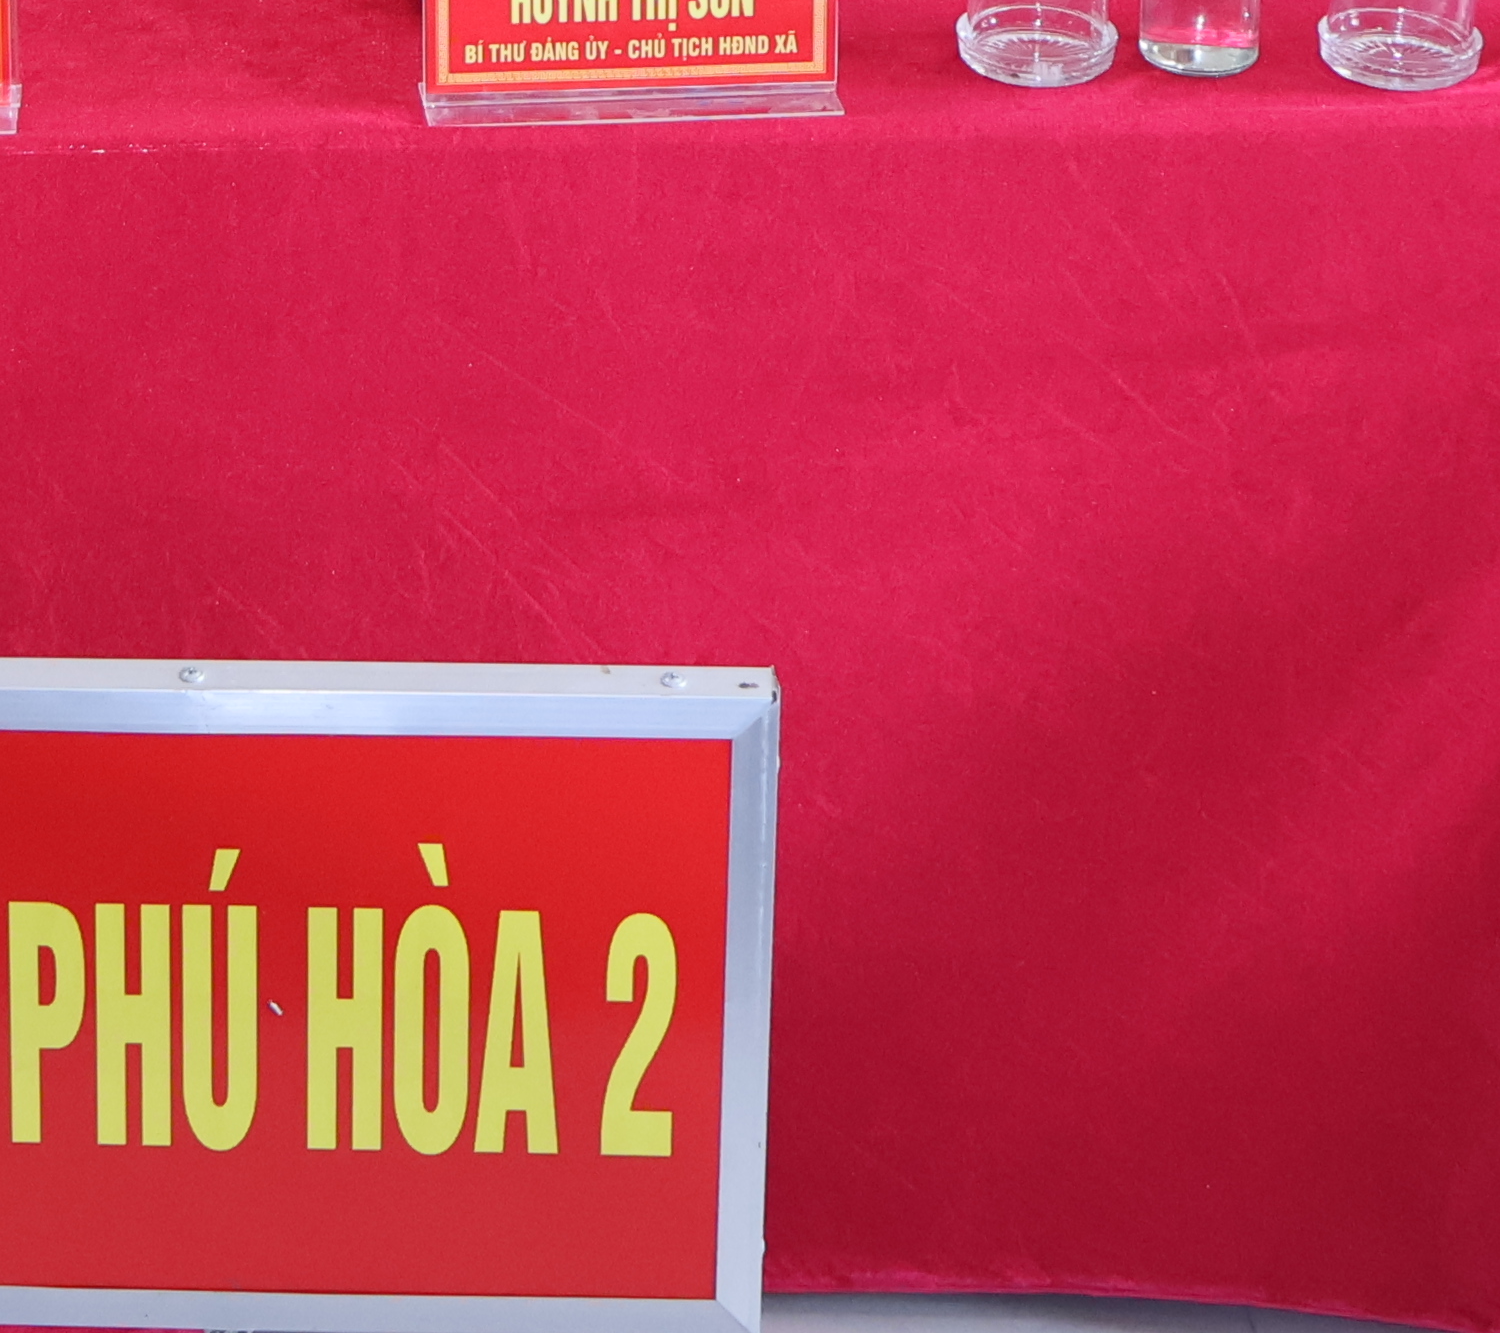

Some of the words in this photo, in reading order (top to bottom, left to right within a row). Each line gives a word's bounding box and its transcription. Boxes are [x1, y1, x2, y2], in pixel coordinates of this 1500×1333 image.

[464, 39, 484, 64] BÍ
[489, 38, 527, 64] THƯ
[530, 35, 580, 62] ĐẢNG
[584, 34, 608, 61] ỦY
[628, 33, 667, 59] CHỦ
[671, 36, 713, 62] TỊCH
[719, 34, 770, 57] HĐND
[774, 30, 798, 55] XÃ
[7, 848, 260, 1151] PHÚ
[306, 842, 559, 1156] HÒA
[599, 913, 678, 1158] 2
